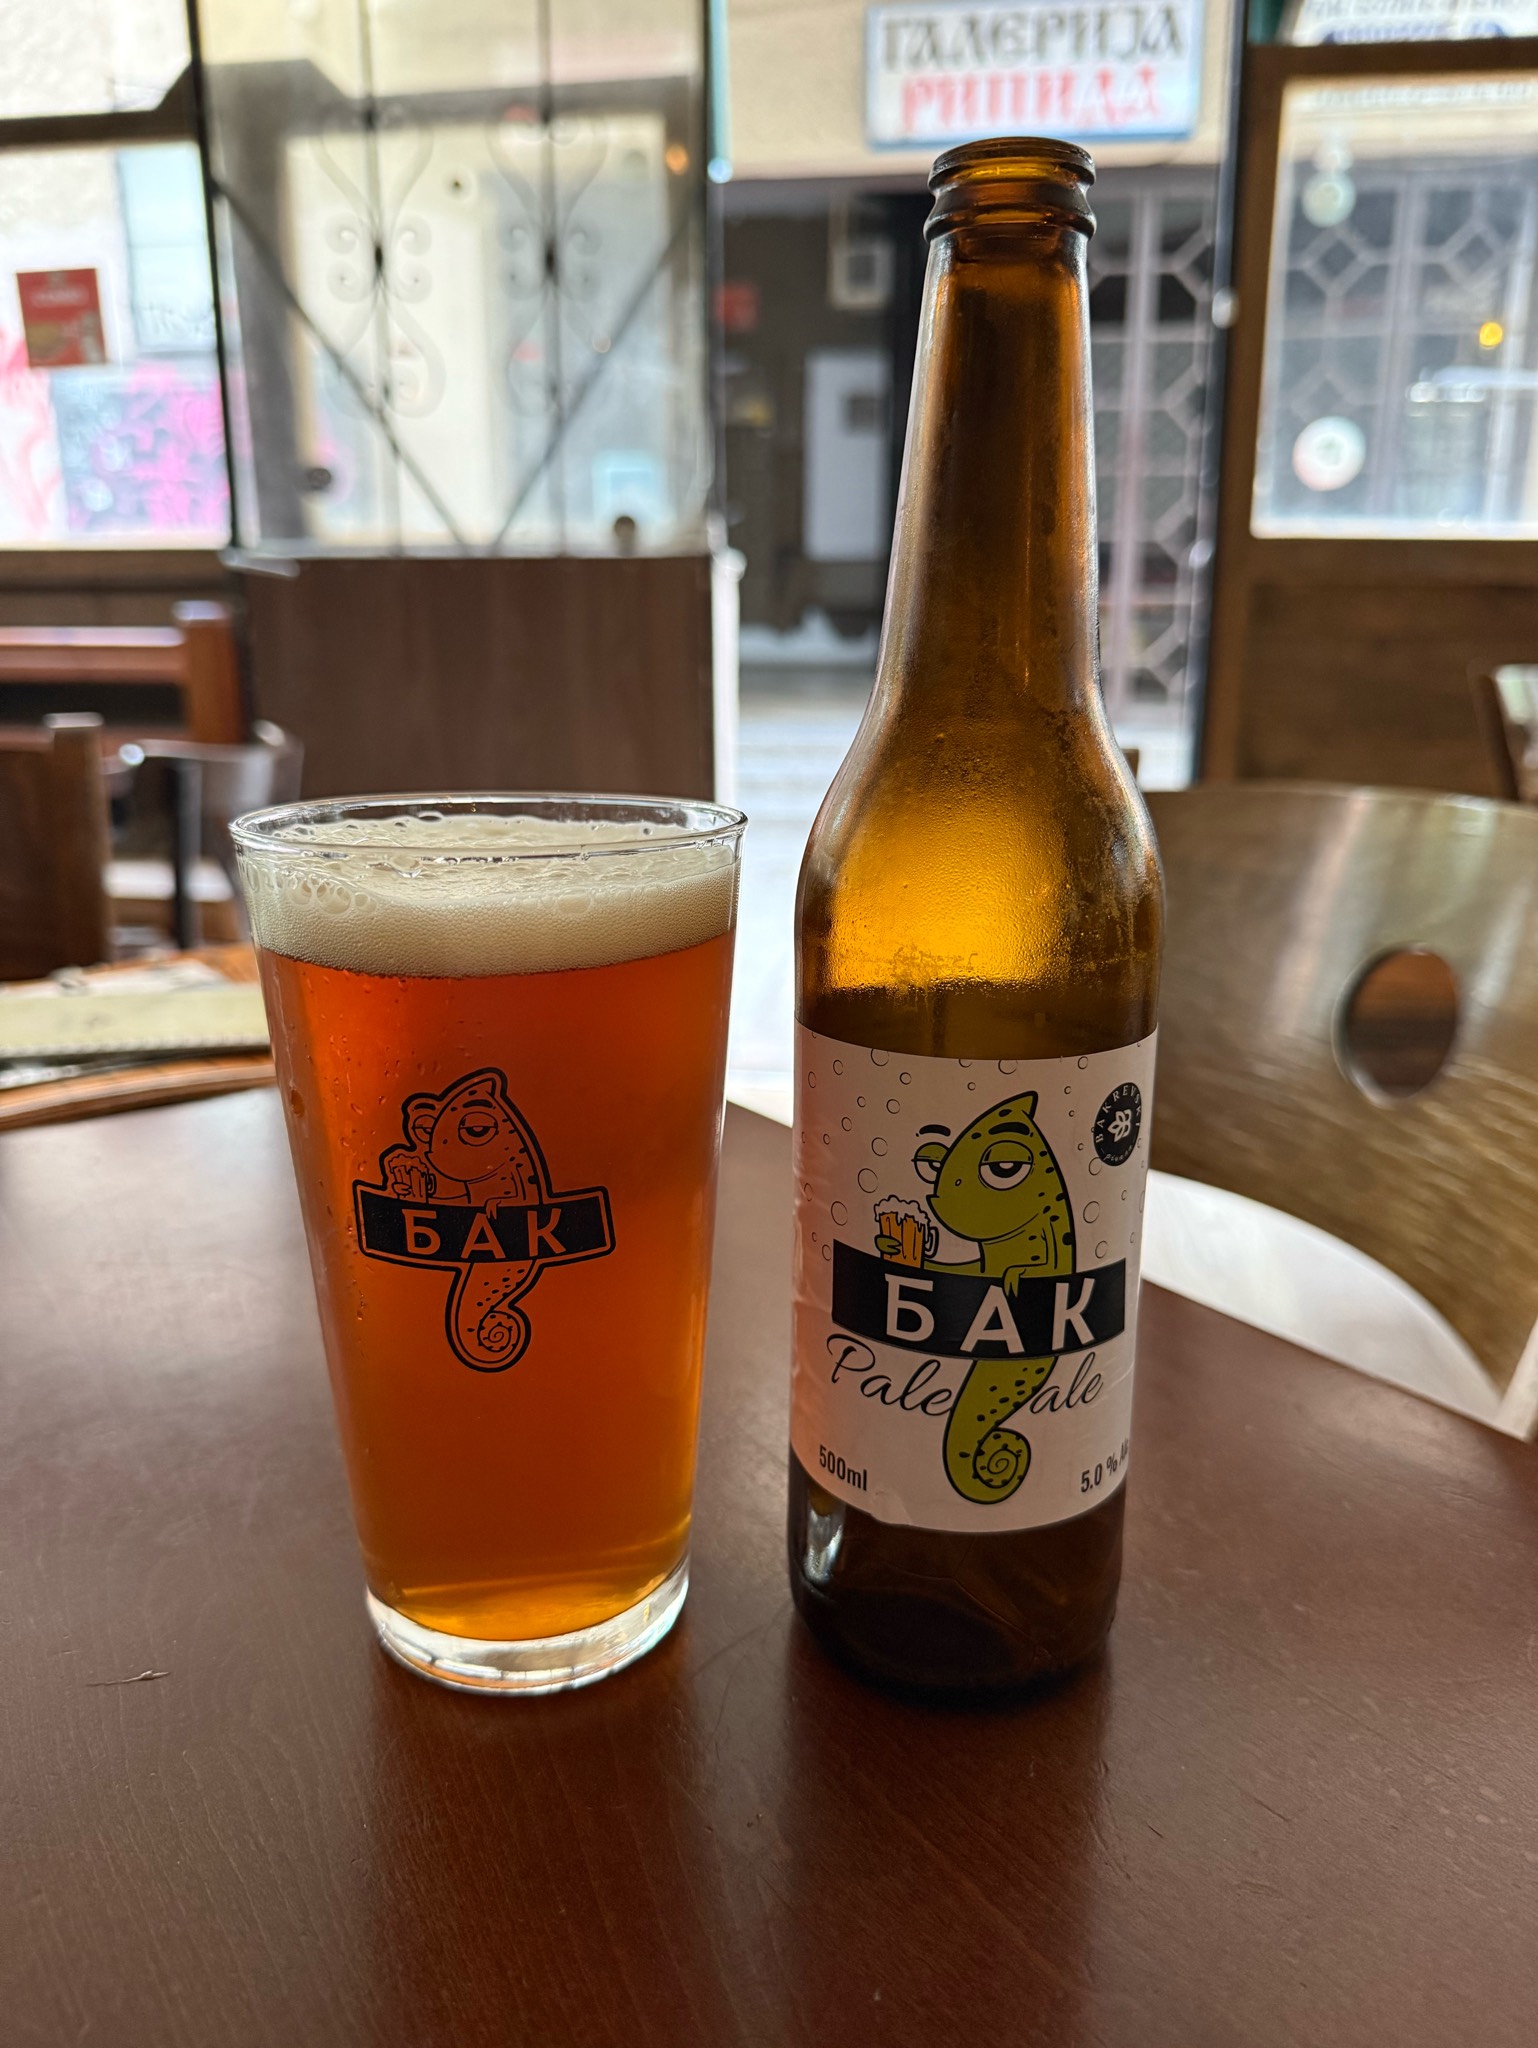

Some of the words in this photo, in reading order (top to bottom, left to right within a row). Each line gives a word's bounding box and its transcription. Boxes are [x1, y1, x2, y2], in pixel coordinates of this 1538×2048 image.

[402, 1207, 566, 1260] БАК
[884, 1273, 1096, 1354] БАК
[826, 1333, 953, 1416] Pale
[1029, 1351, 1104, 1414] ale
[819, 1444, 868, 1491] 500ml
[1081, 1463, 1103, 1493] 5.0
